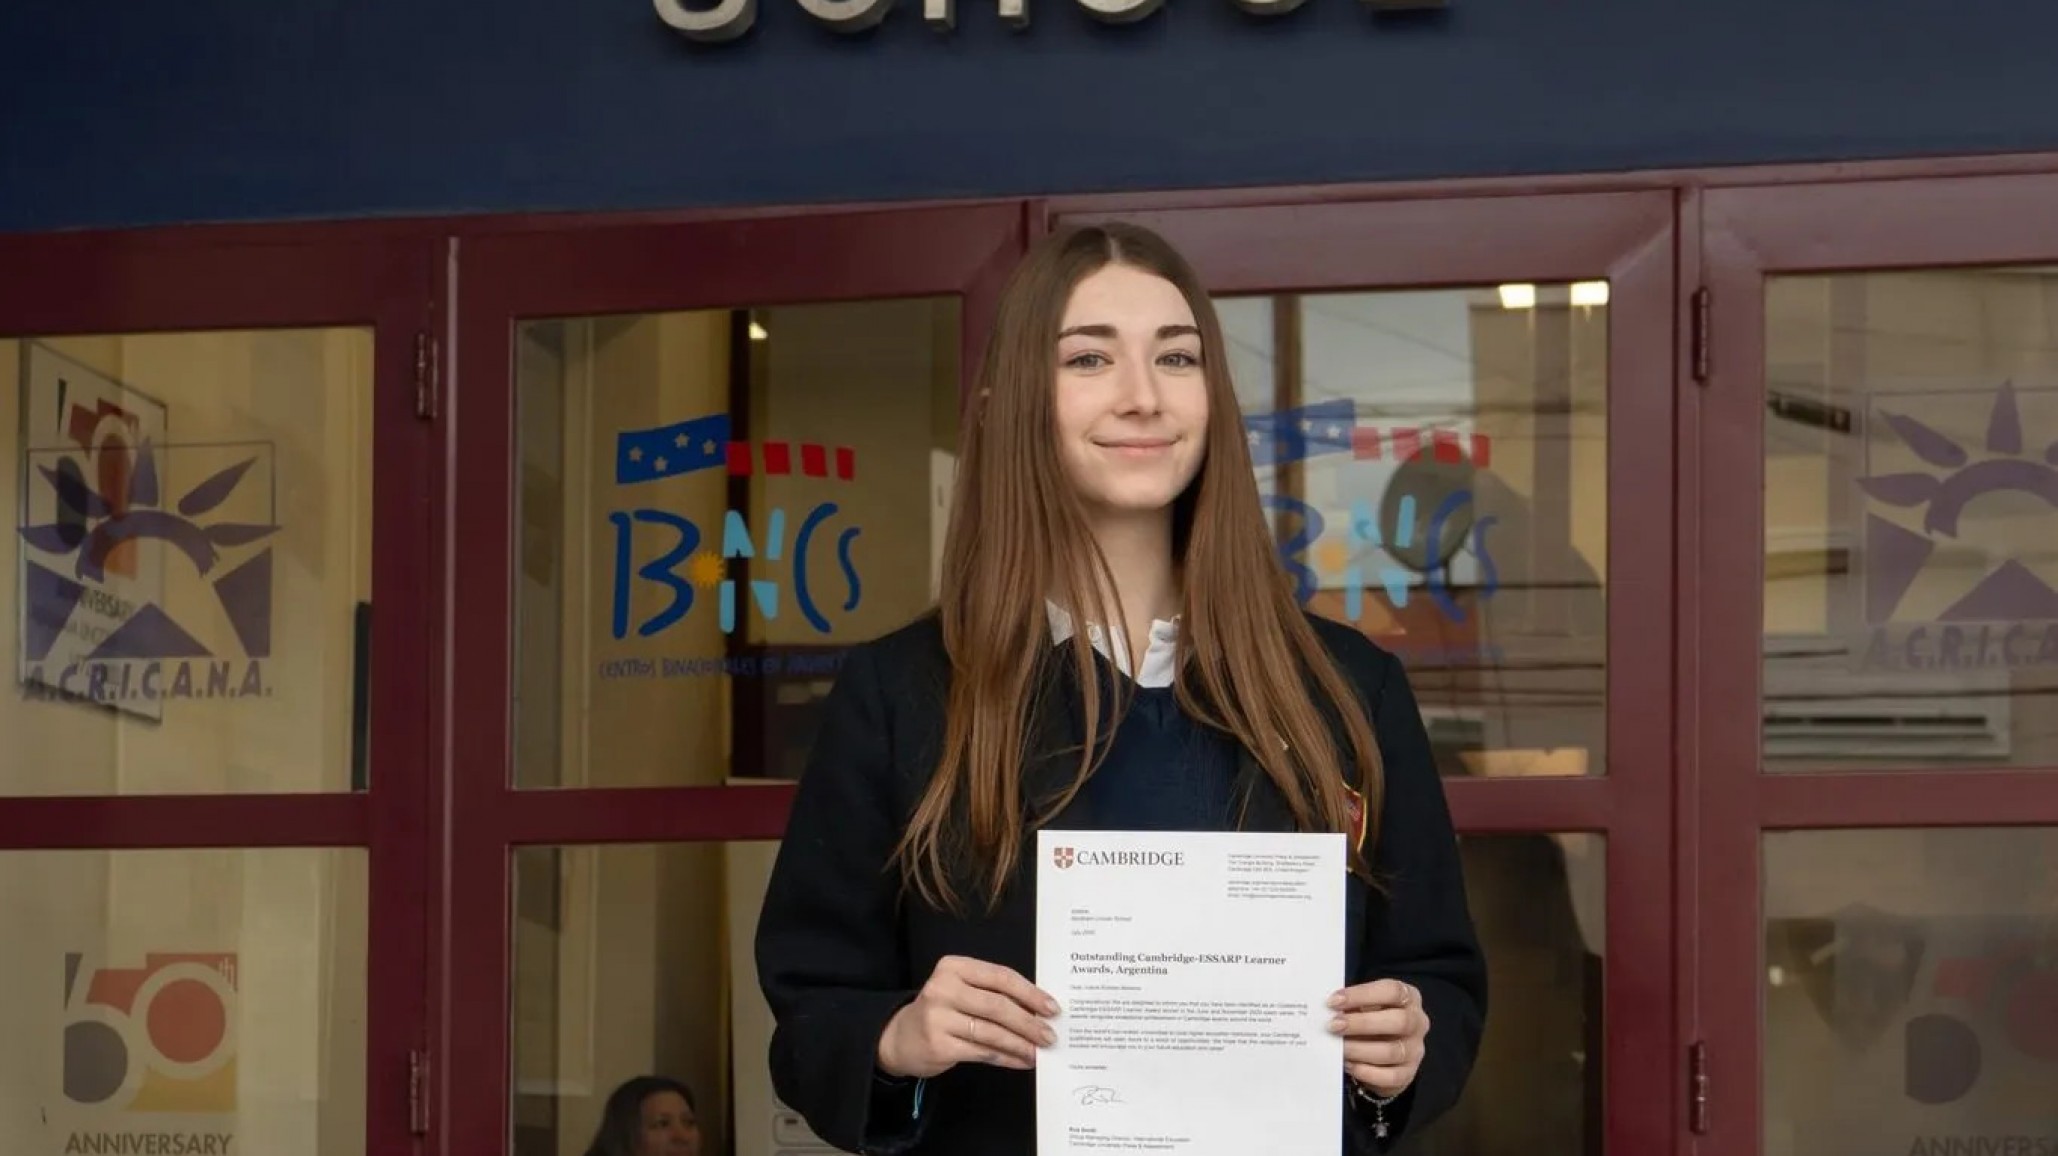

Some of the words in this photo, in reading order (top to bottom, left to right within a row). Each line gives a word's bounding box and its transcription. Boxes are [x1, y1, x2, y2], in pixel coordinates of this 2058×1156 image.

[1077, 850, 1184, 867] CAMBRIDGE
[1070, 952, 1136, 963] Outstanding
[1137, 953, 1242, 965] Cambridge-ESSARP
[1244, 955, 1286, 966] Learner
[1070, 964, 1114, 975] Awards,
[1115, 965, 1168, 977] Argentina
[65, 1132, 233, 1155] ANNIVERSARY
